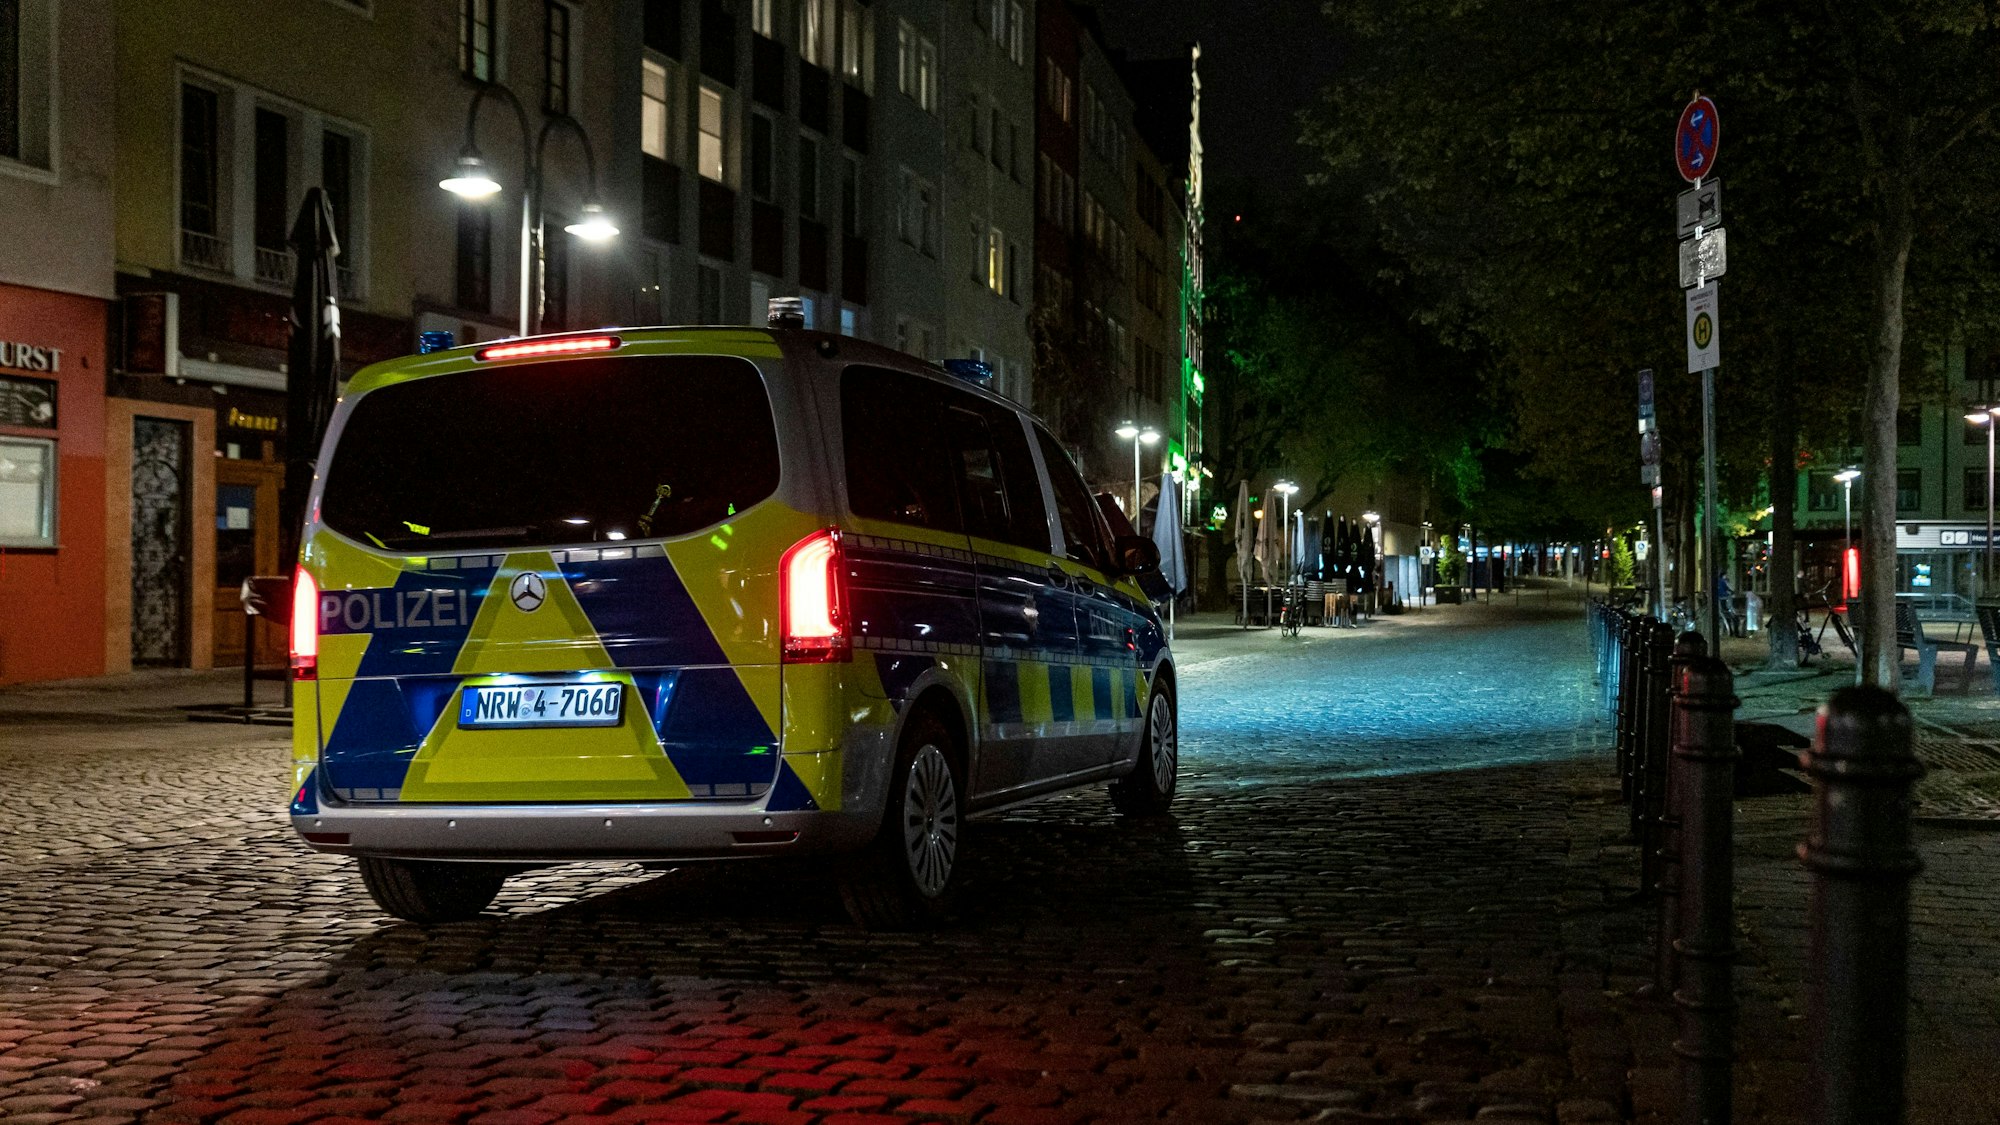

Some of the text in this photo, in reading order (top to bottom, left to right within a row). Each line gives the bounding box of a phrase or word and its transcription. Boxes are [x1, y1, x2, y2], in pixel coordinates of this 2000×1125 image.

[0, 341, 63, 373] URST
[321, 589, 468, 631] POLIZEI
[465, 709, 472, 717] D
[476, 687, 620, 720] NRW 4-7060
